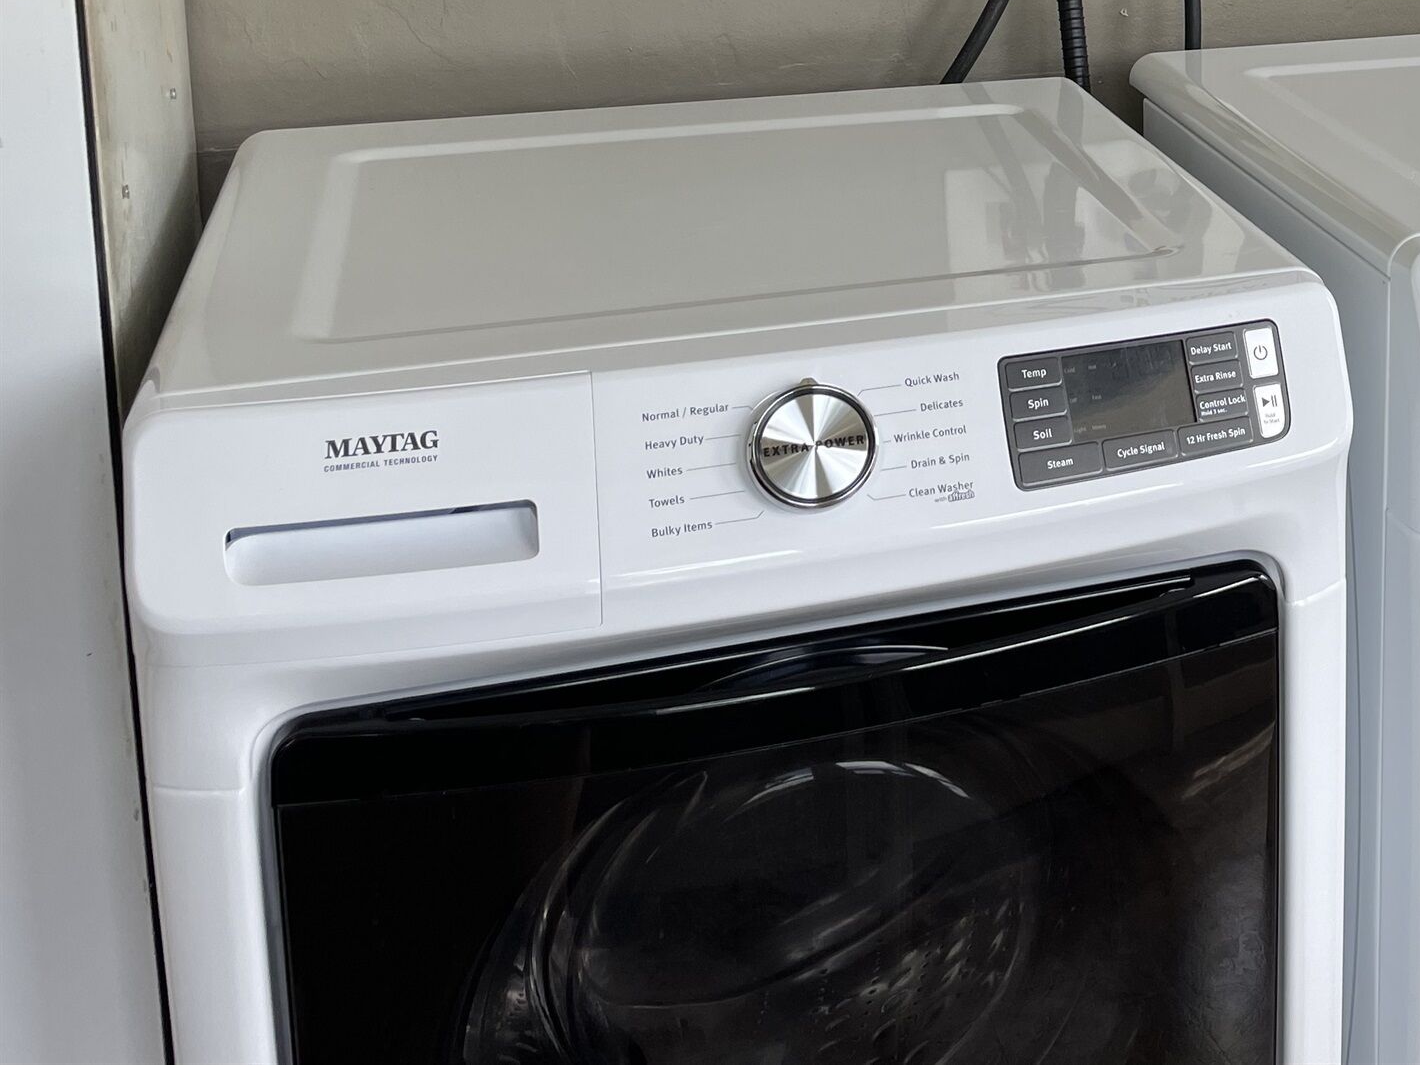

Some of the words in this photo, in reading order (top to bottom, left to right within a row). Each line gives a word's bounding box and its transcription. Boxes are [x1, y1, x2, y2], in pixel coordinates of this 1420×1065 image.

[1191, 346, 1212, 355] Delay
[1213, 343, 1232, 352] Start
[905, 375, 931, 388] Quick
[934, 372, 960, 383] Wash
[1021, 367, 1047, 380] Temp
[1195, 375, 1214, 383] Extra
[1216, 371, 1236, 380] Rinse
[920, 398, 964, 412] Delicates
[1028, 397, 1049, 410] Spin
[1200, 398, 1227, 410] Control
[1228, 395, 1246, 404] Lock
[642, 409, 680, 422] Normal
[690, 403, 729, 418] Regular
[894, 430, 931, 443] Wrinkle
[934, 425, 967, 439] Control
[1033, 428, 1053, 440] Soil
[1187, 436, 1196, 445] 12
[1196, 434, 1205, 443] Hr
[1206, 431, 1227, 441] Fresh
[1228, 427, 1246, 439] Spin
[325, 430, 439, 459] MAYTAG
[645, 437, 677, 452] Heavy
[680, 434, 704, 448] Duty
[763, 442, 810, 458] EXTRA
[815, 435, 865, 451] POWER
[1117, 445, 1138, 459] Cycle
[1140, 442, 1165, 456] Signal
[324, 460, 380, 473] COMMERCIAL
[384, 455, 438, 467] TECHNOLOGY
[911, 457, 936, 469] Drain
[939, 455, 947, 465] &
[950, 453, 970, 466] Spin
[1047, 457, 1074, 469] Steam
[647, 466, 683, 479] Whites
[909, 487, 936, 498] Clean
[937, 482, 974, 494] Washer
[649, 495, 685, 509] Towels
[652, 525, 681, 538] Bulky
[684, 520, 713, 534] Items
